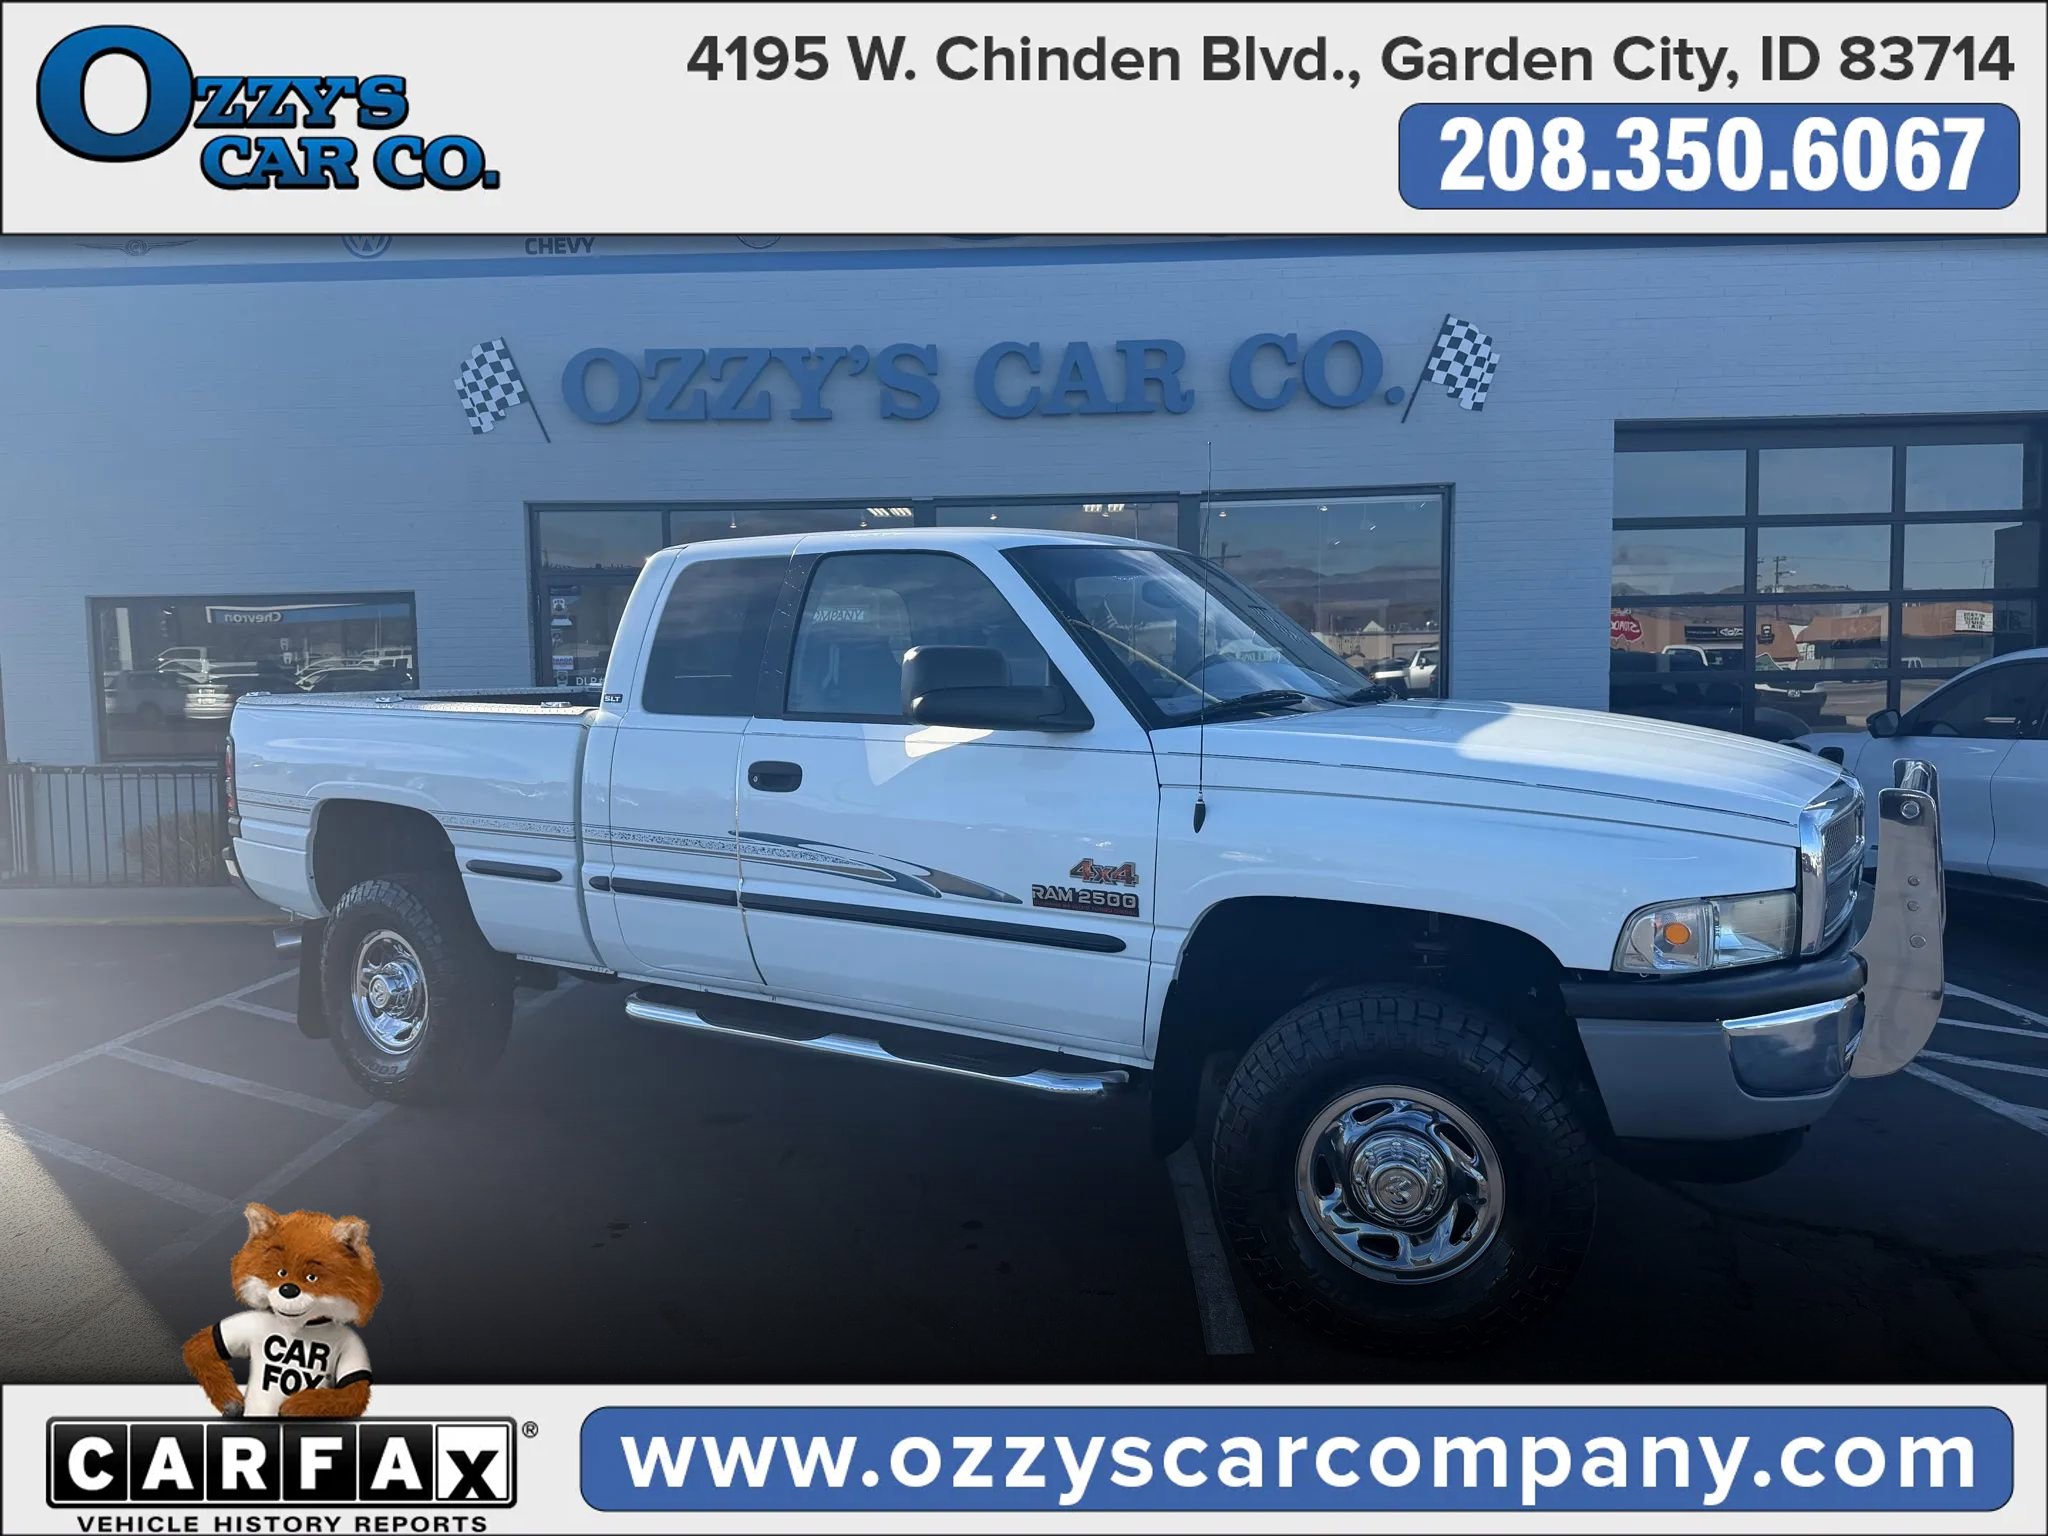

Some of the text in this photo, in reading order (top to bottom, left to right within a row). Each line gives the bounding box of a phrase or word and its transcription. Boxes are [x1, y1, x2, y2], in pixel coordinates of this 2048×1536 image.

[524, 237, 596, 255] CHEVY
[561, 329, 1406, 425] OZZY'S CAR CO.
[1069, 858, 1139, 887] 4x4
[1031, 885, 1073, 902] RAM
[1078, 889, 1138, 909] 2500
